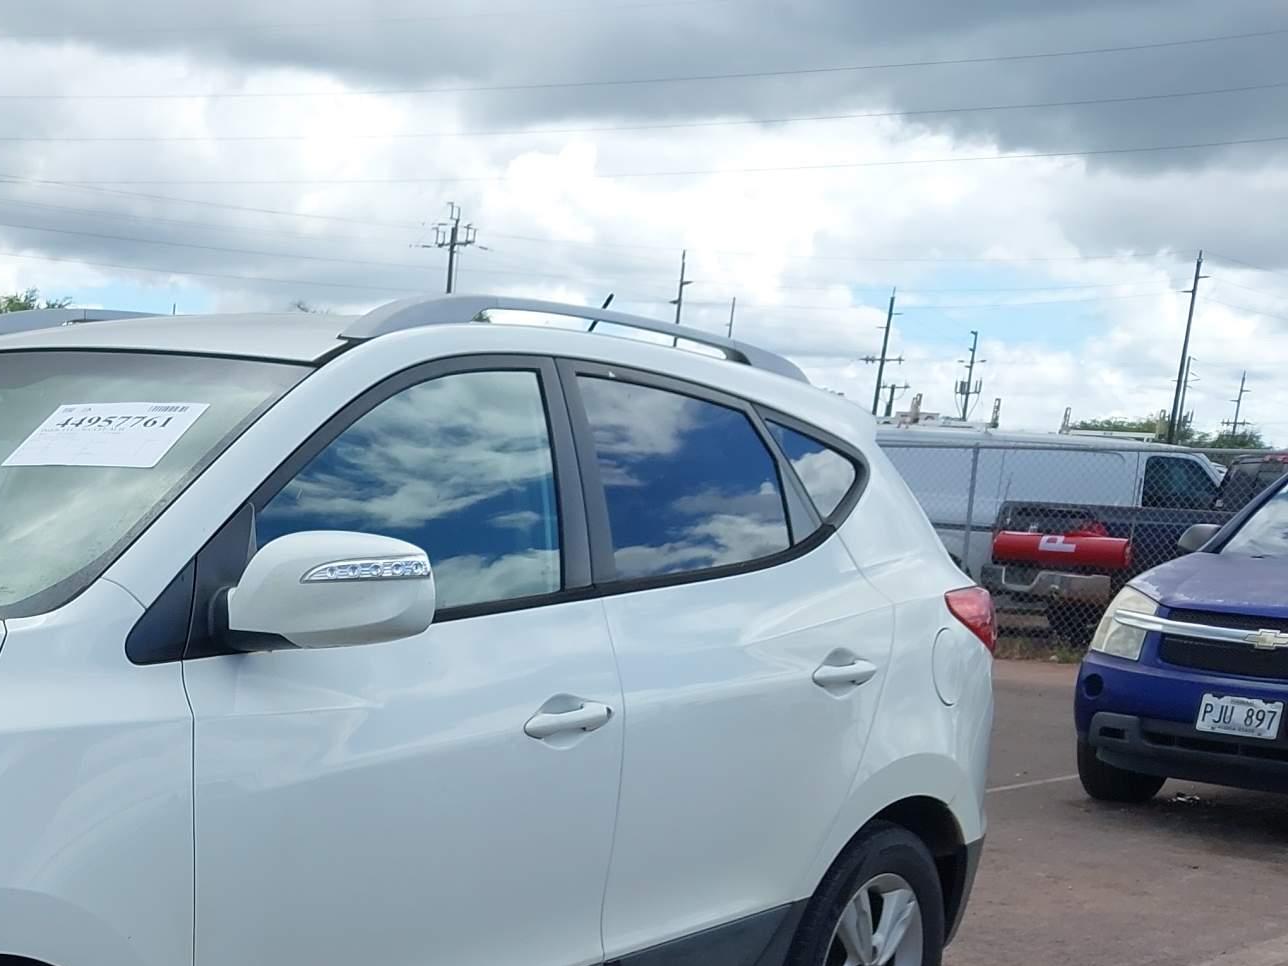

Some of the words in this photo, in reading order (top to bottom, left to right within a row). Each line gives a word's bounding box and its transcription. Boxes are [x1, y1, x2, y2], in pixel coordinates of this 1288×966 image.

[56, 416, 173, 427] 44957761
[1201, 703, 1235, 724] PJU
[1244, 708, 1278, 730] 897
